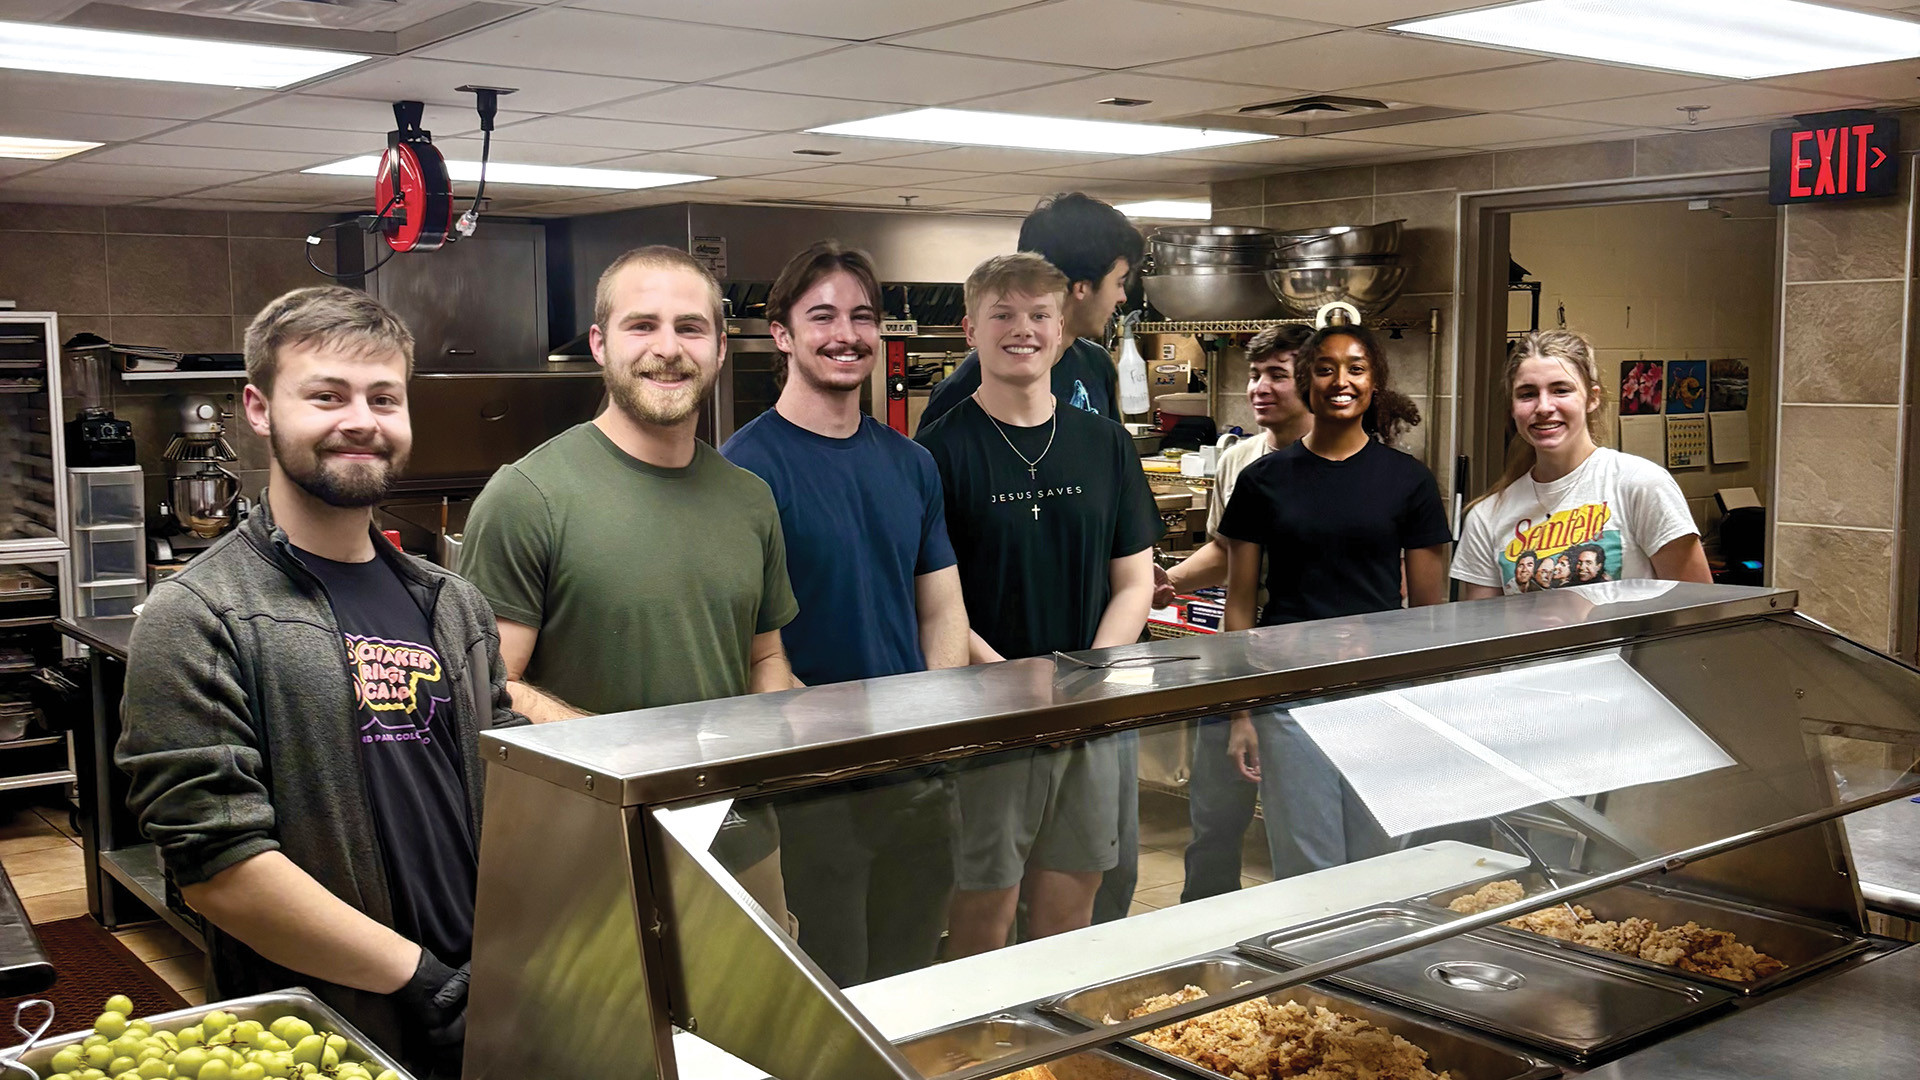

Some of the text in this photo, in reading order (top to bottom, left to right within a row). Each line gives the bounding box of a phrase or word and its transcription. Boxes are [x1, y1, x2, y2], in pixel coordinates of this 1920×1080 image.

[1790, 124, 1875, 198] EXIT
[991, 486, 1082, 503] JESUS SAVES
[1509, 501, 1608, 558] Seinfeld
